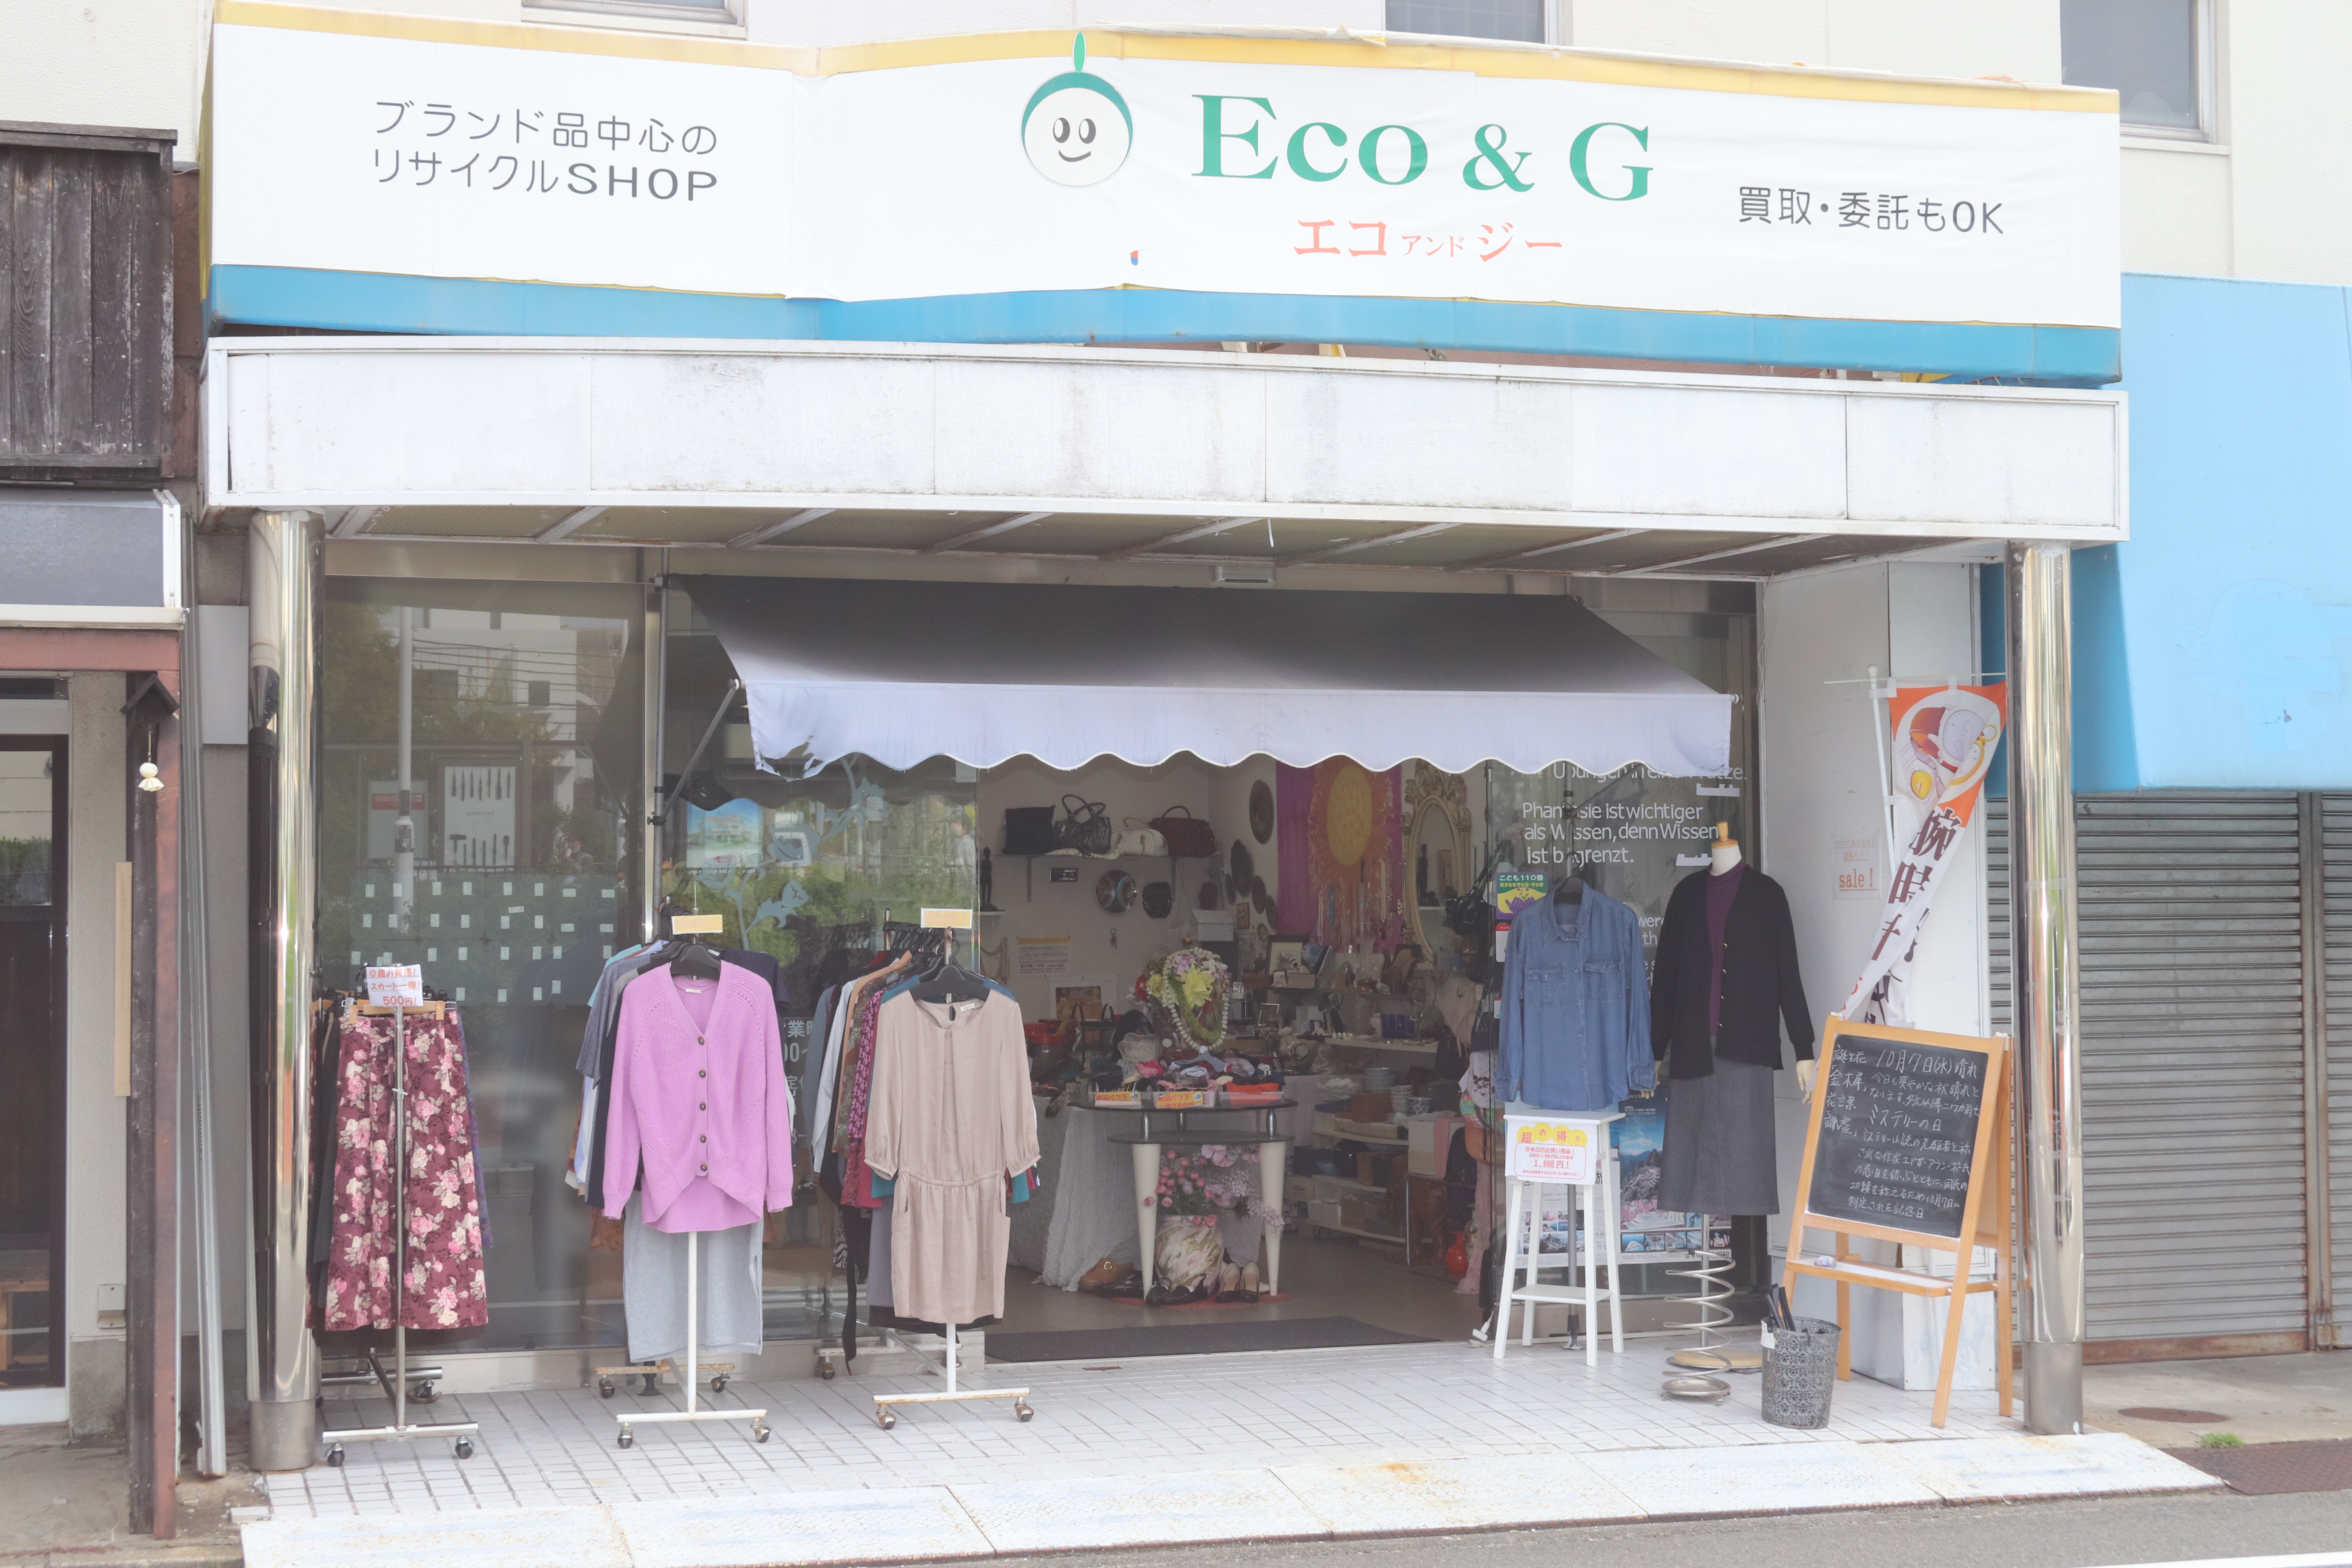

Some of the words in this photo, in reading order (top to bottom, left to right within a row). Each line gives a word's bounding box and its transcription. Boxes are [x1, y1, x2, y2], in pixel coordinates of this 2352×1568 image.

[376, 100, 717, 155] ブランド品中心の
[1192, 95, 1427, 185] Eco
[1463, 124, 1534, 192] &
[1570, 123, 1653, 201] G
[375, 149, 717, 201] リサイクルSHOP
[1739, 186, 2004, 234] 買取・委託もOK
[1523, 802, 1601, 818] Phansie
[1606, 803, 1625, 819] ist
[1627, 802, 1703, 824] wichtiger
[1524, 824, 1546, 840] als
[1550, 823, 1617, 843] Wssen,
[1619, 822, 1658, 839] denn
[1658, 823, 1718, 840] Wissen
[1527, 846, 1548, 864] ist
[1553, 846, 1634, 867] bgrenzt.
[1869, 1103, 1942, 1132] ミステリーの日
